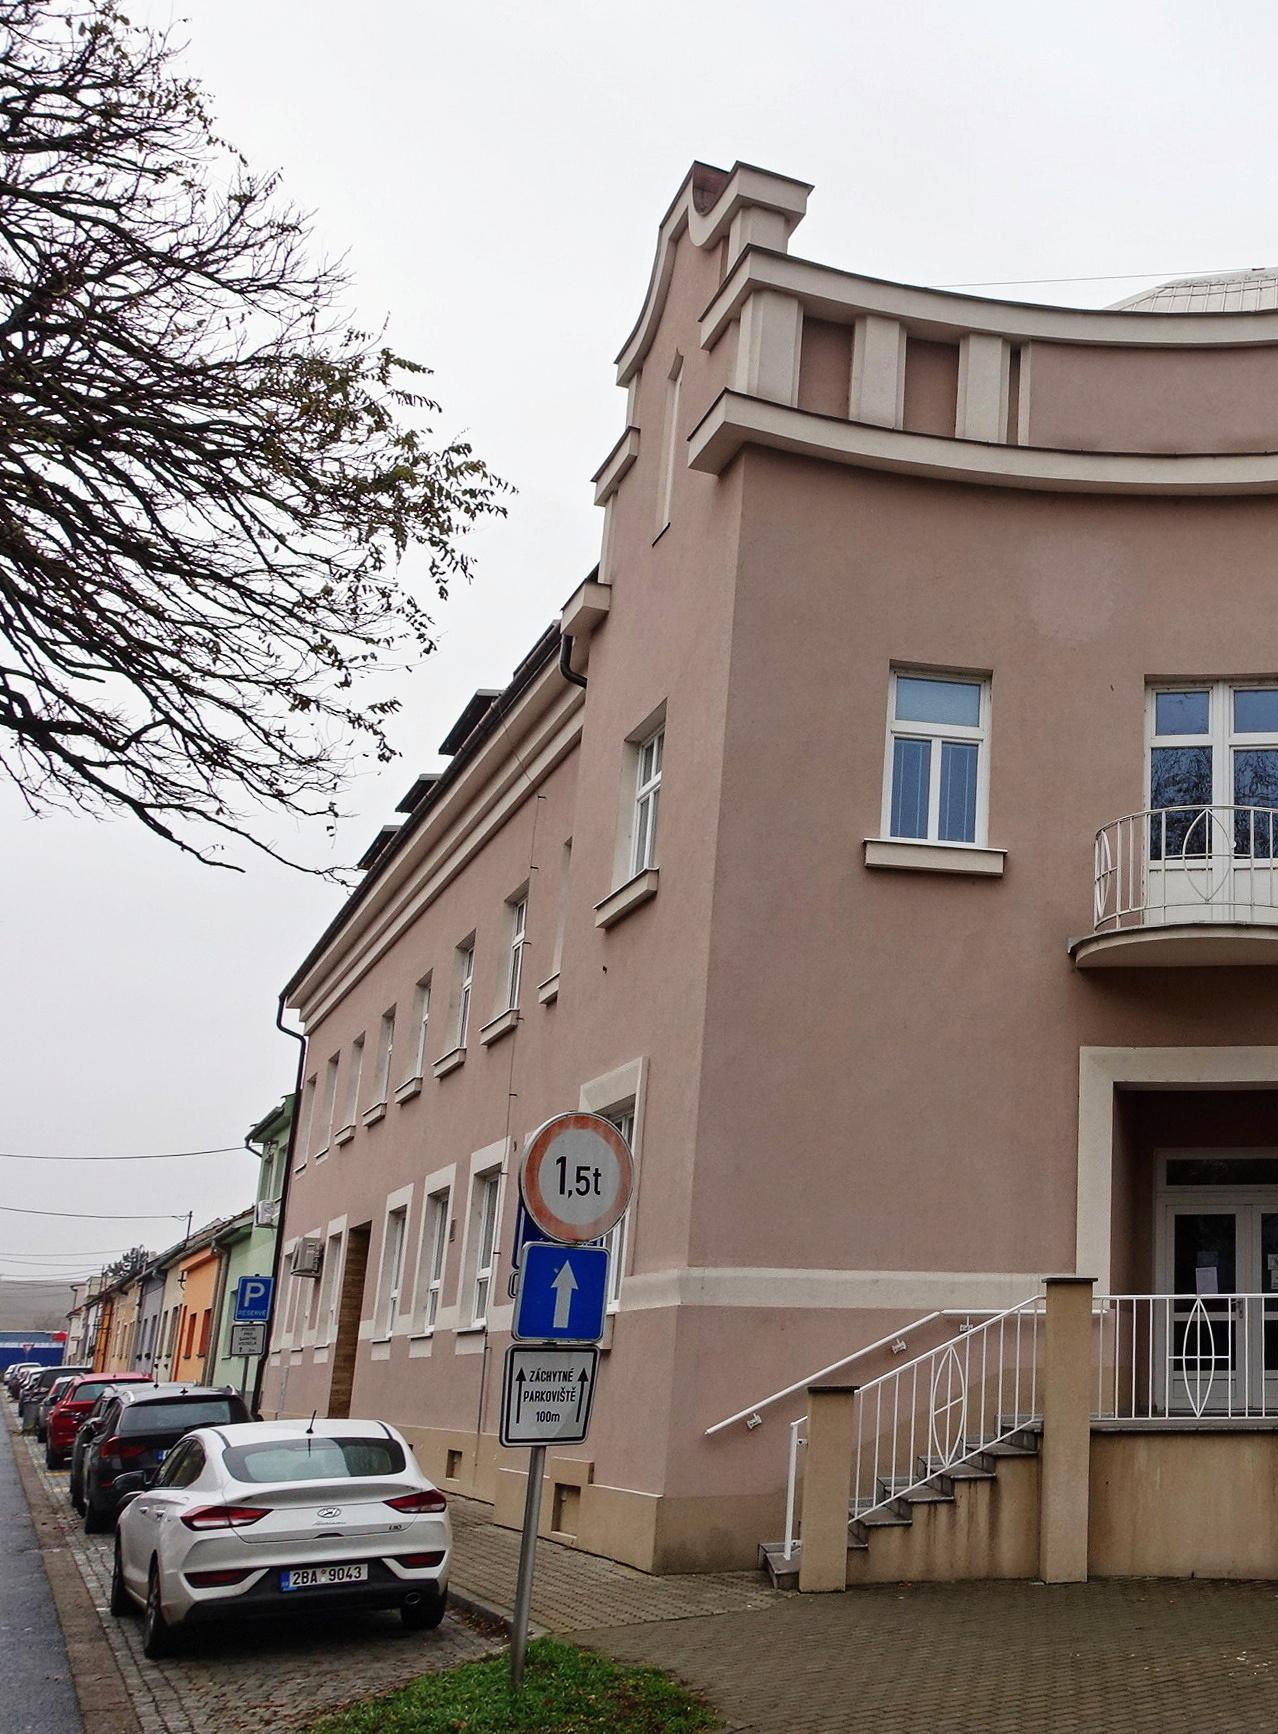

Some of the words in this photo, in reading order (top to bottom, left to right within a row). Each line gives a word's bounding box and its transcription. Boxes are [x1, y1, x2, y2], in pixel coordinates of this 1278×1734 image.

[556, 1156, 601, 1199] 1,5t
[244, 1282, 266, 1307] P
[529, 1367, 575, 1382] ZÁCHYTNÉ
[523, 1386, 576, 1402] PARKOVIŠTĚ
[536, 1411, 561, 1423] 100m
[292, 1571, 318, 1585] 2BA
[328, 1566, 362, 1582] 9043
